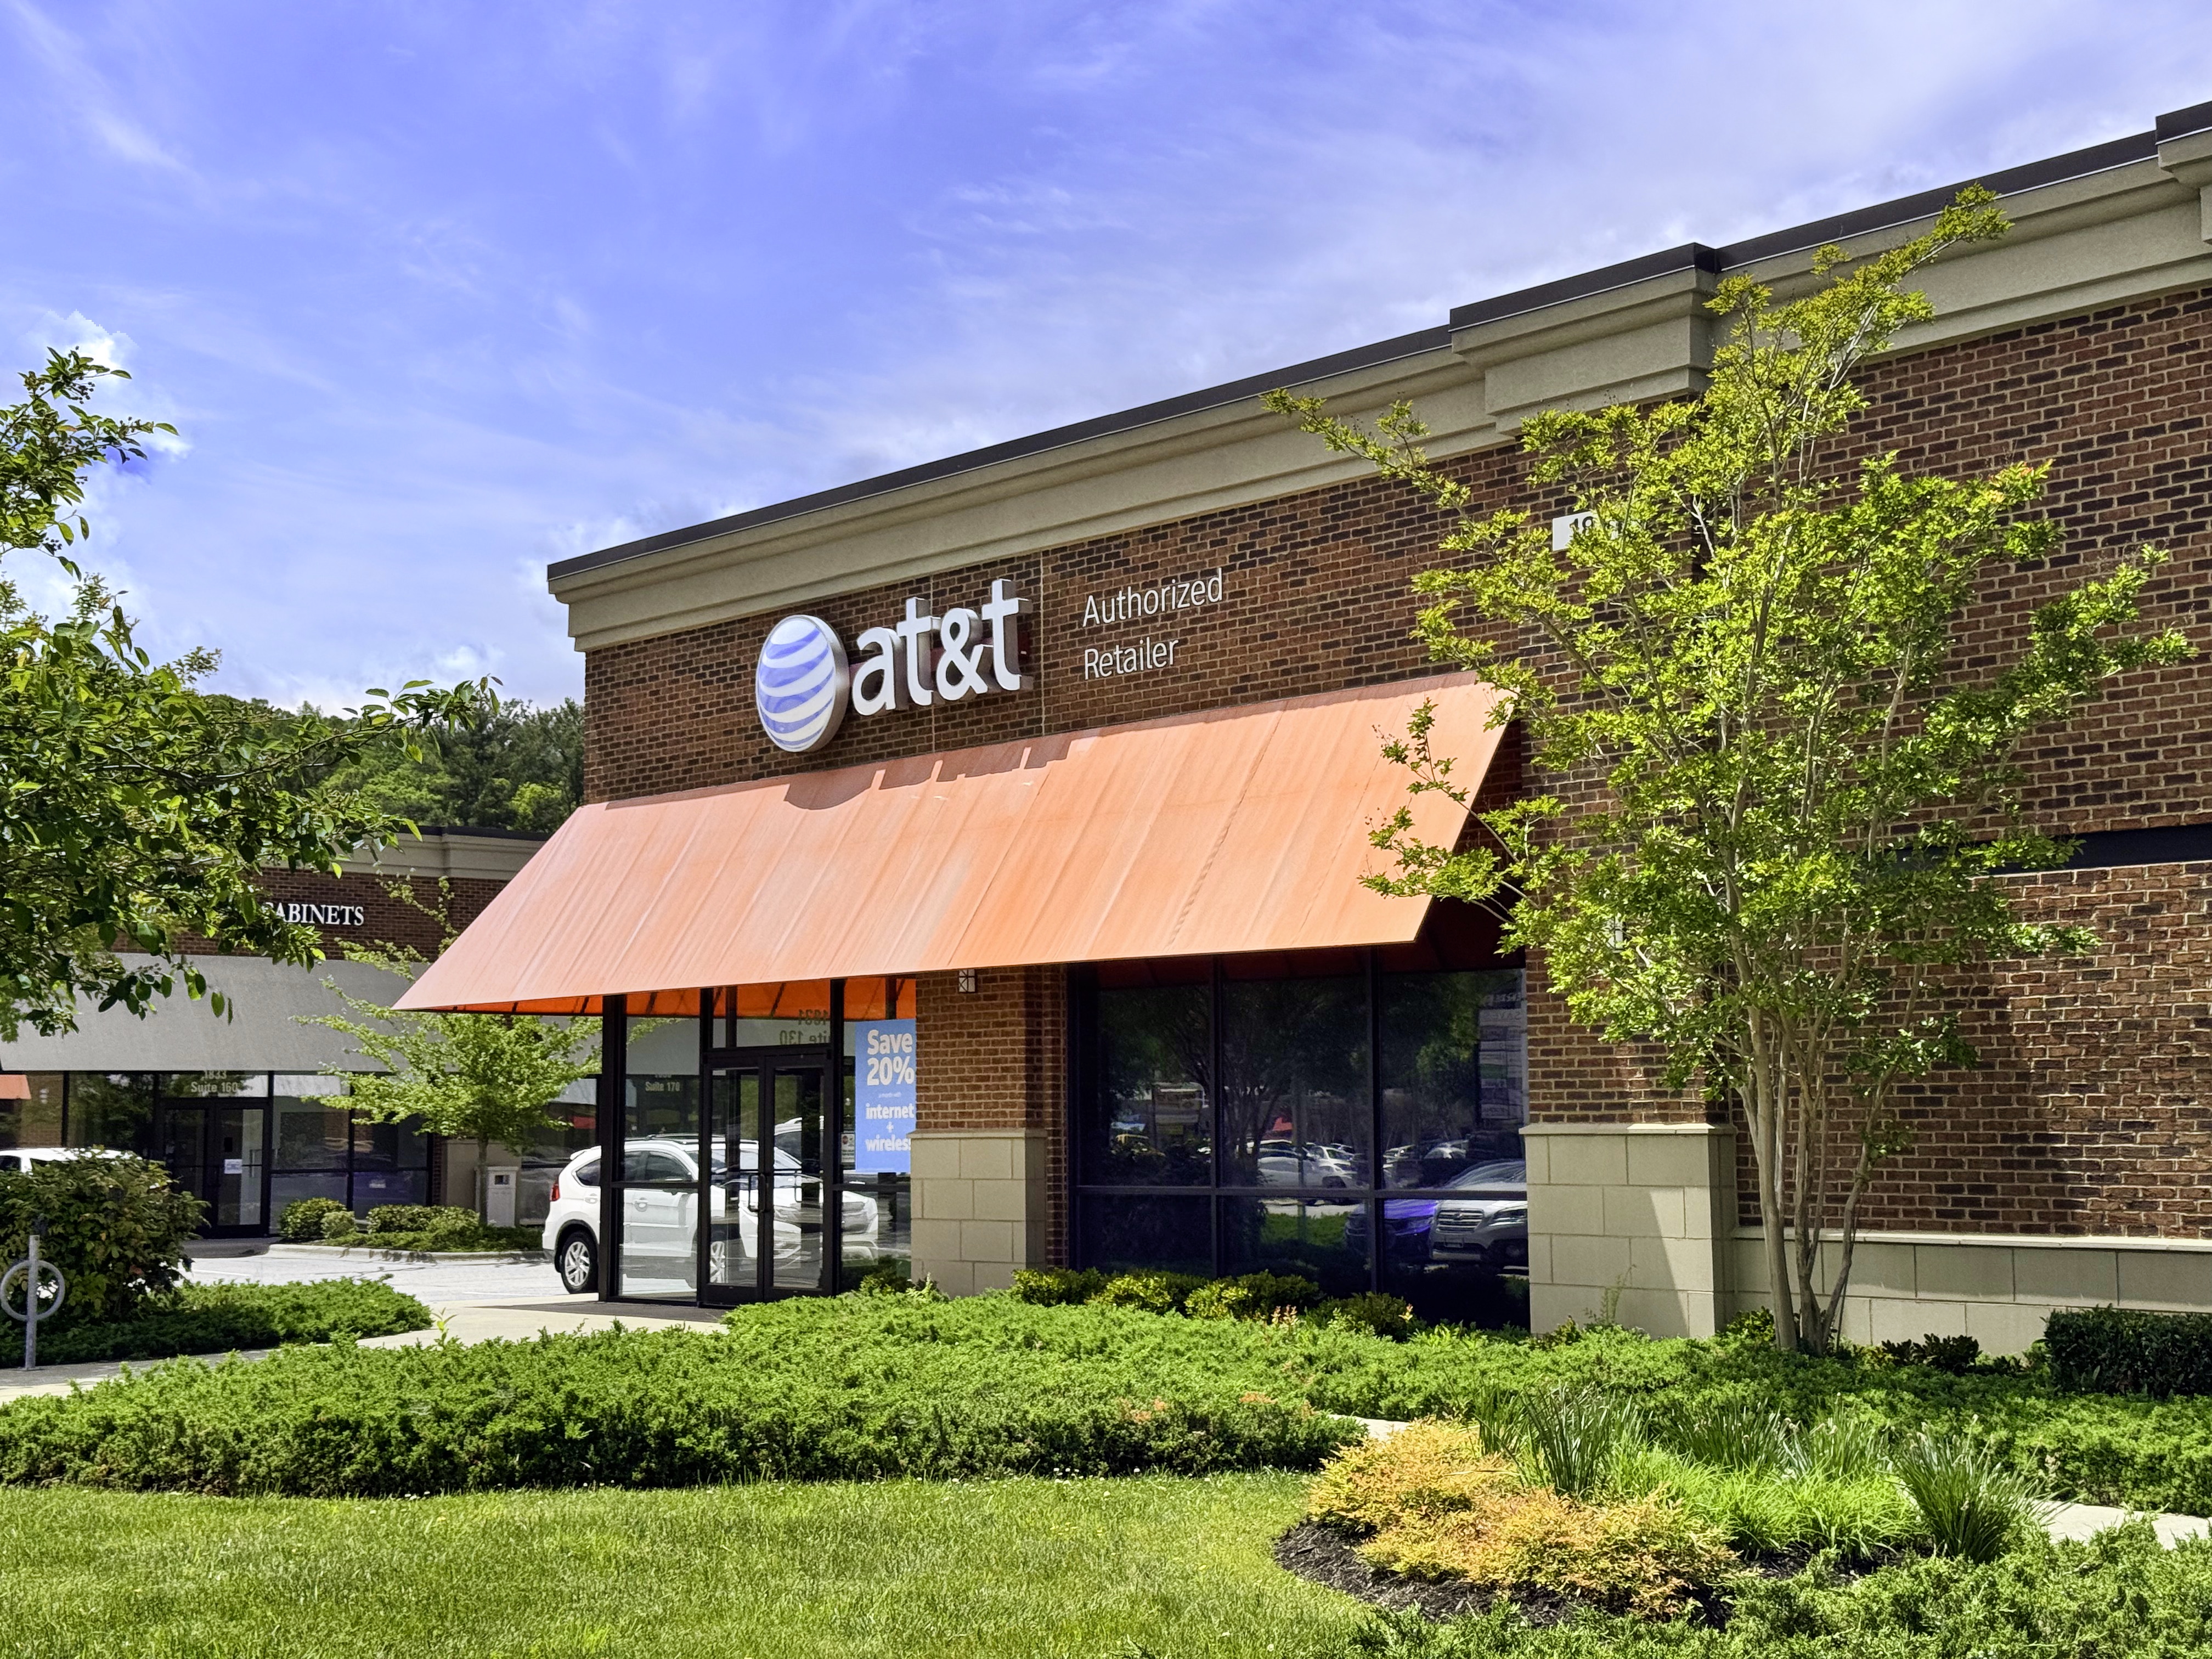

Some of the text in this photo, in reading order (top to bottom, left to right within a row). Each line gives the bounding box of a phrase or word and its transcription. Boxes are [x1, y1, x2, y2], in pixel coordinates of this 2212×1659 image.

[1082, 568, 1223, 627] Authorized
[852, 579, 1027, 716] at&t
[1084, 639, 1179, 680] Retailer
[266, 902, 364, 926] ABINETS
[867, 1029, 913, 1055] Save
[867, 1056, 915, 1086] 20%
[191, 1081, 238, 1092] Suite 160
[667, 1082, 680, 1092] 170
[865, 1103, 915, 1120] internet
